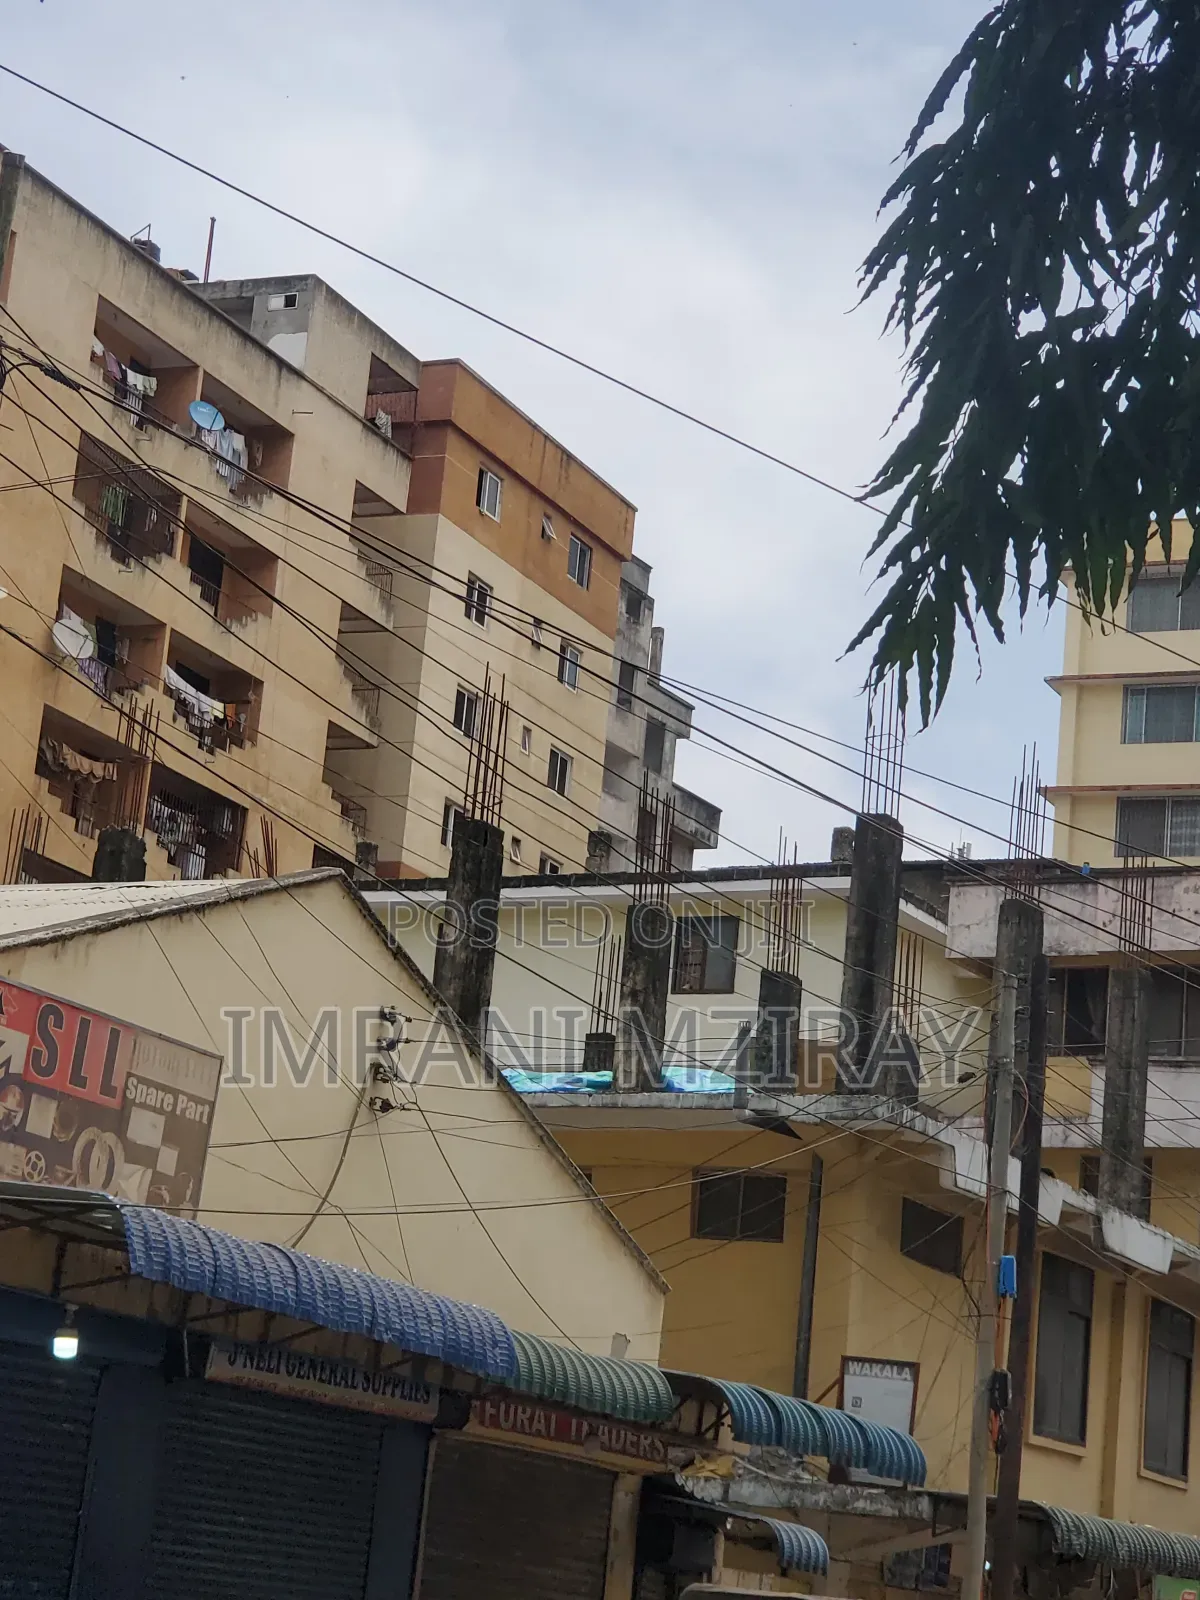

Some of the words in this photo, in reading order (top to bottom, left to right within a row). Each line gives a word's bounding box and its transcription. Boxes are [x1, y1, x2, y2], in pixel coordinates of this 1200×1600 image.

[125, 1076, 174, 1113] Spare
[176, 1095, 210, 1125] Part
[285, 1351, 358, 1390] GENERAL
[362, 1371, 431, 1405] SUPPLIES
[847, 1360, 912, 1381] WAKALA
